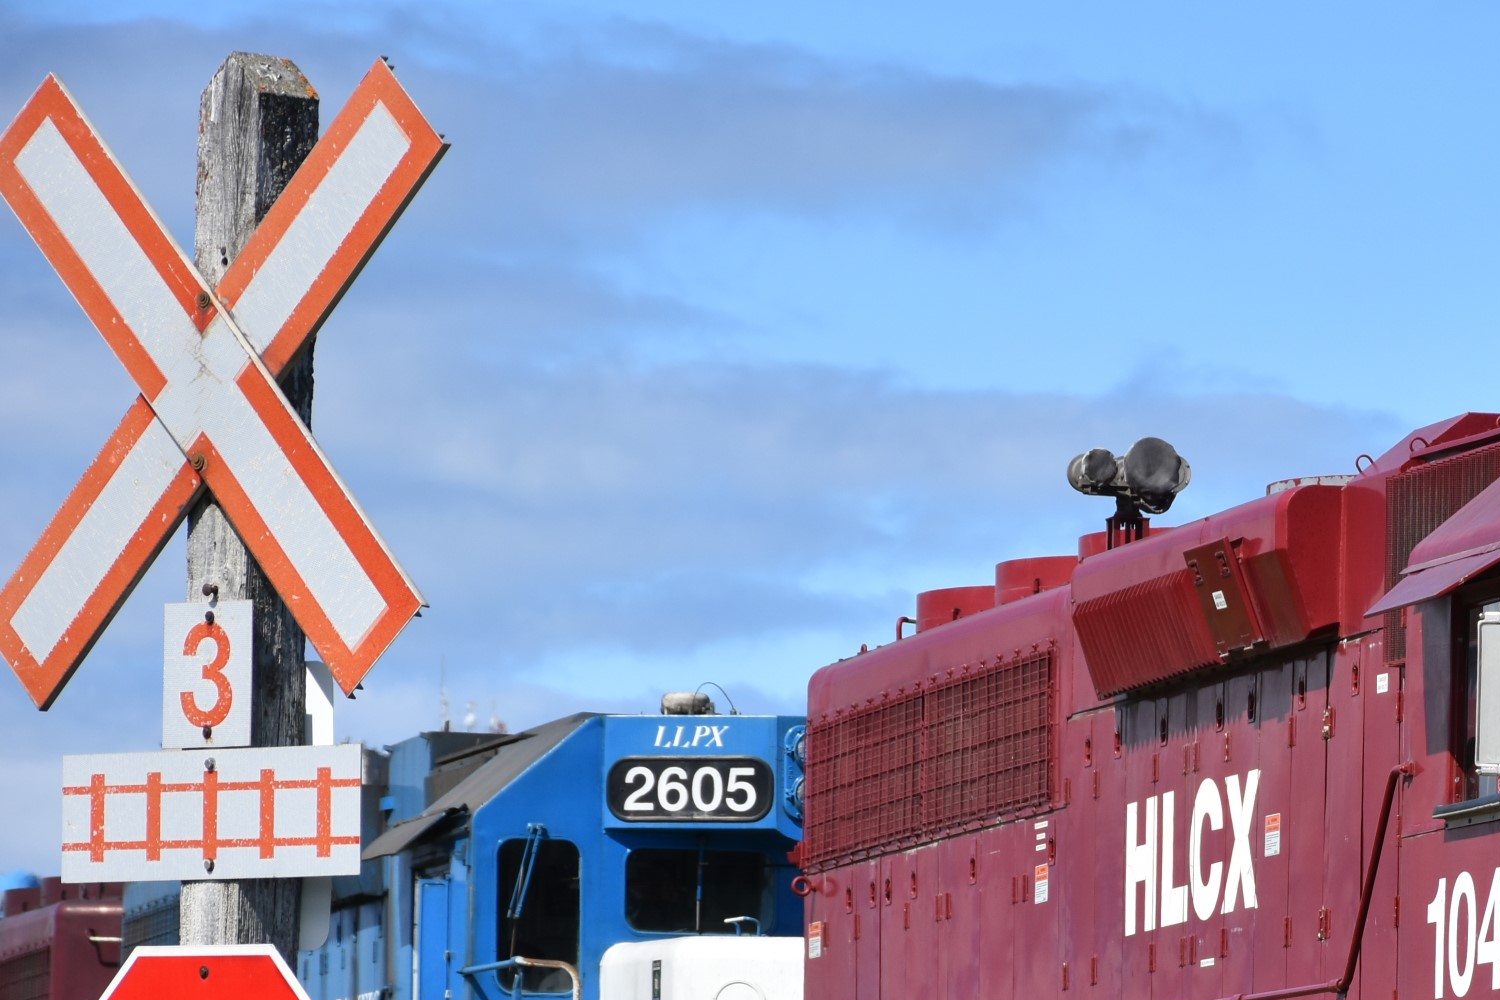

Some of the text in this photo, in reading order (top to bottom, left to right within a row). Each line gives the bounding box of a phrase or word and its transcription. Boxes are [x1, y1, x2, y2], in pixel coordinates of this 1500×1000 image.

[181, 622, 233, 728] 3
[653, 725, 730, 748] LLPX
[623, 766, 757, 812] 2605
[1124, 768, 1262, 937] HLCX
